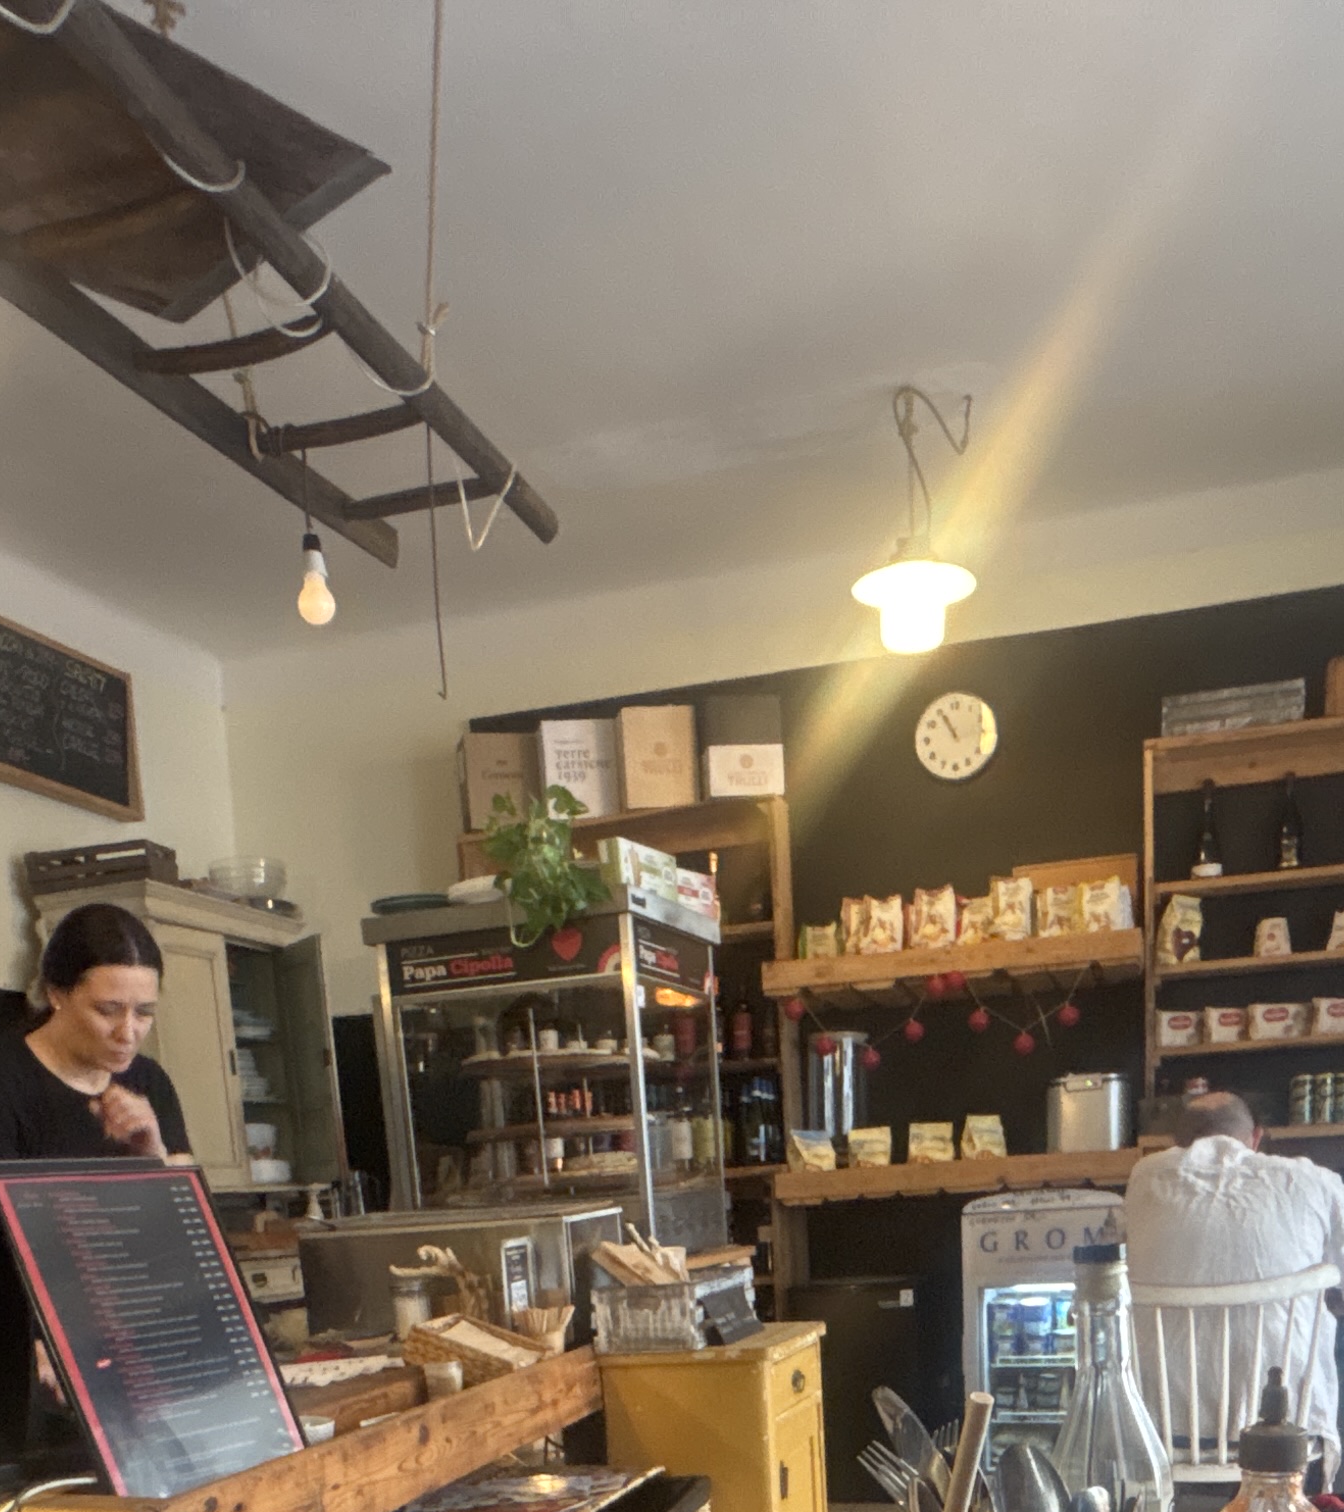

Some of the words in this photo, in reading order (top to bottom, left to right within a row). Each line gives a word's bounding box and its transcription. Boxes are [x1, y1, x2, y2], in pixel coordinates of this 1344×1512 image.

[402, 964, 447, 981] Papa
[449, 954, 514, 976] Cipolla
[979, 1226, 1105, 1253] GROM
